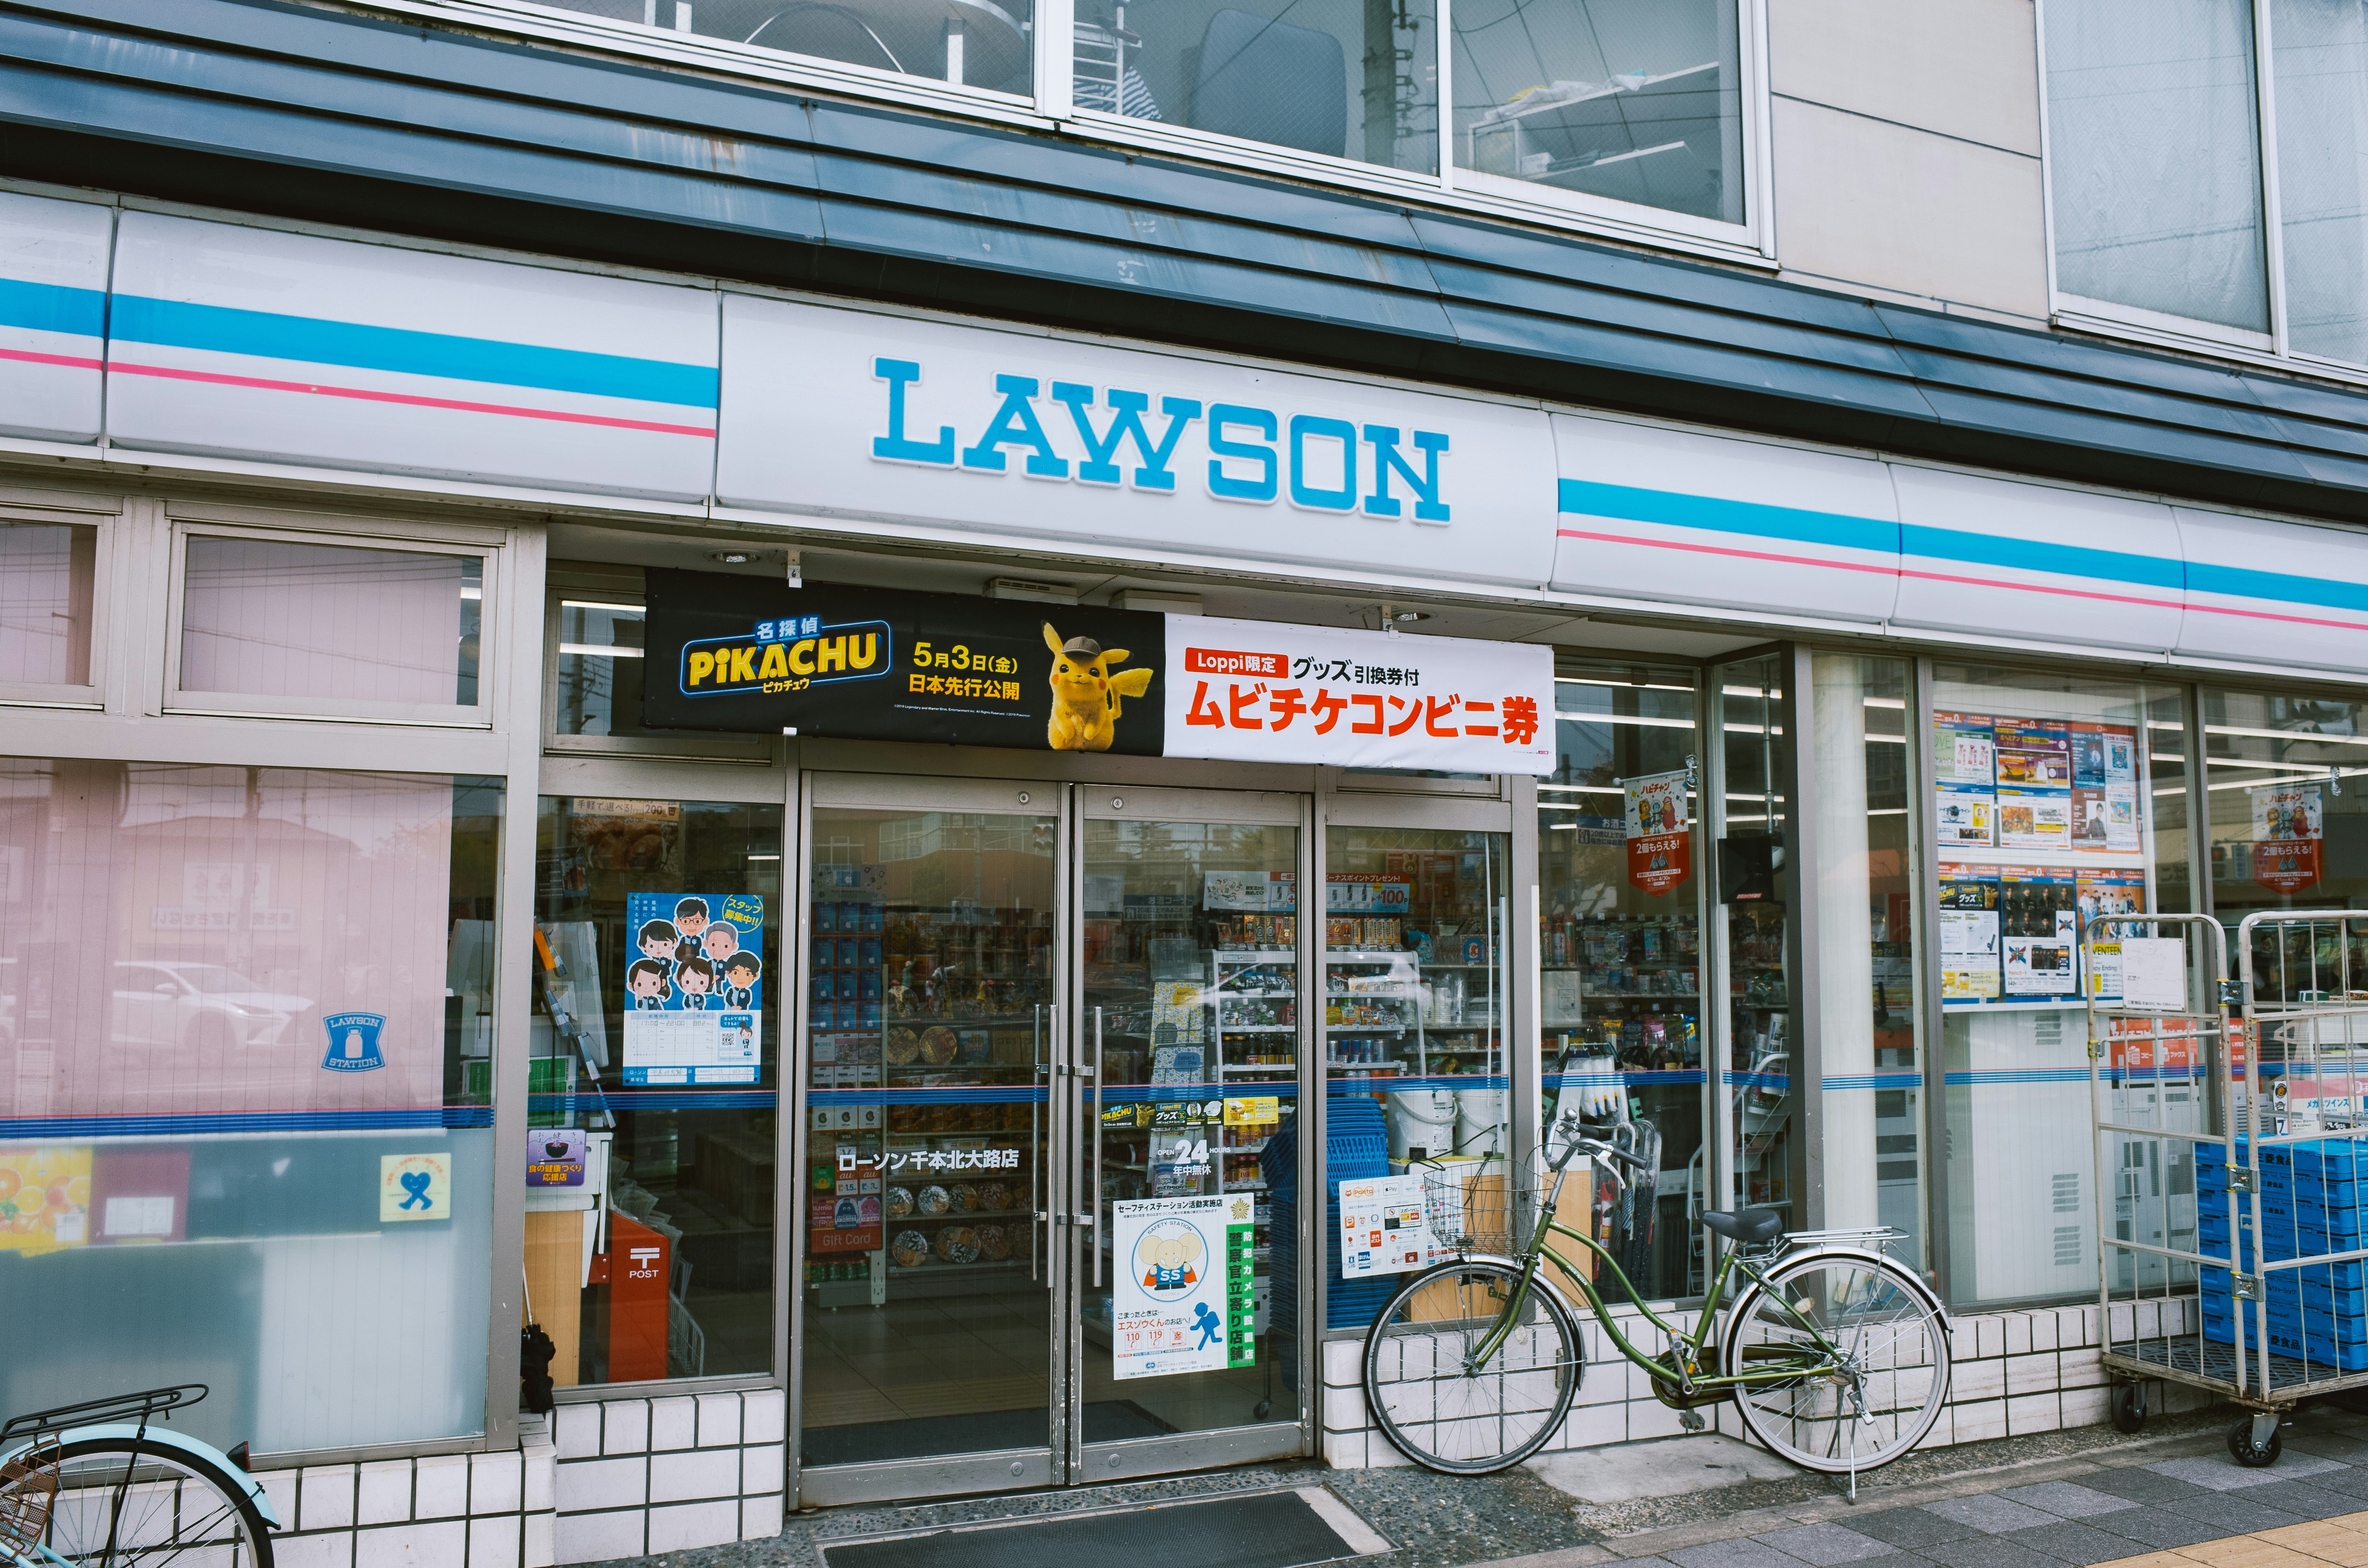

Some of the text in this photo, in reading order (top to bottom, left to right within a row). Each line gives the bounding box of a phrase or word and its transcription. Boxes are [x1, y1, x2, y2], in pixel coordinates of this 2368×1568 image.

[873, 357, 1450, 522] LAWSON
[757, 617, 818, 639] 名探偵
[913, 642, 1018, 674] 5月3日(金)
[1198, 653, 1276, 673] Loppi限定
[763, 678, 809, 693] ピカチュウ
[910, 674, 1019, 700] 日本先行公開
[1185, 680, 1538, 745] ムビチケコンビニ券
[1636, 840, 1679, 854] 2個もらえる!
[2263, 845, 2312, 856] 2個もらえる!
[1959, 894, 1976, 902] グッズ
[728, 898, 762, 914] スタッフ
[330, 1017, 380, 1028] LAWSON
[329, 1057, 378, 1068] STATION
[1156, 1111, 1178, 1120] グッズ
[1174, 1139, 1209, 1164] 24
[839, 1149, 1019, 1171] ローソン千本北大路店
[2258, 1152, 2295, 1166] 三菱食品
[529, 1164, 582, 1173] 食の健康づくり
[1173, 1165, 1211, 1176] 年中無休
[543, 1173, 567, 1181] 応援店
[2261, 1180, 2284, 1189] 三菱食品
[1118, 1199, 1223, 1213] セーフティステーション活動実施店
[2263, 1206, 2285, 1215] 三菱食品
[1147, 1220, 1193, 1235] SAFETY STATION
[823, 1233, 871, 1246] Gift Card
[629, 1270, 659, 1278] POST
[1566, 1265, 1587, 1286] AGENDA
[1229, 1232, 1243, 1361] 警察官立寄り店舗
[1244, 1231, 1253, 1360] 防犯カメラ設置店
[2272, 1285, 2296, 1295] リョーショク
[1126, 1333, 1139, 1341] 110
[1149, 1331, 1162, 1339] 119
